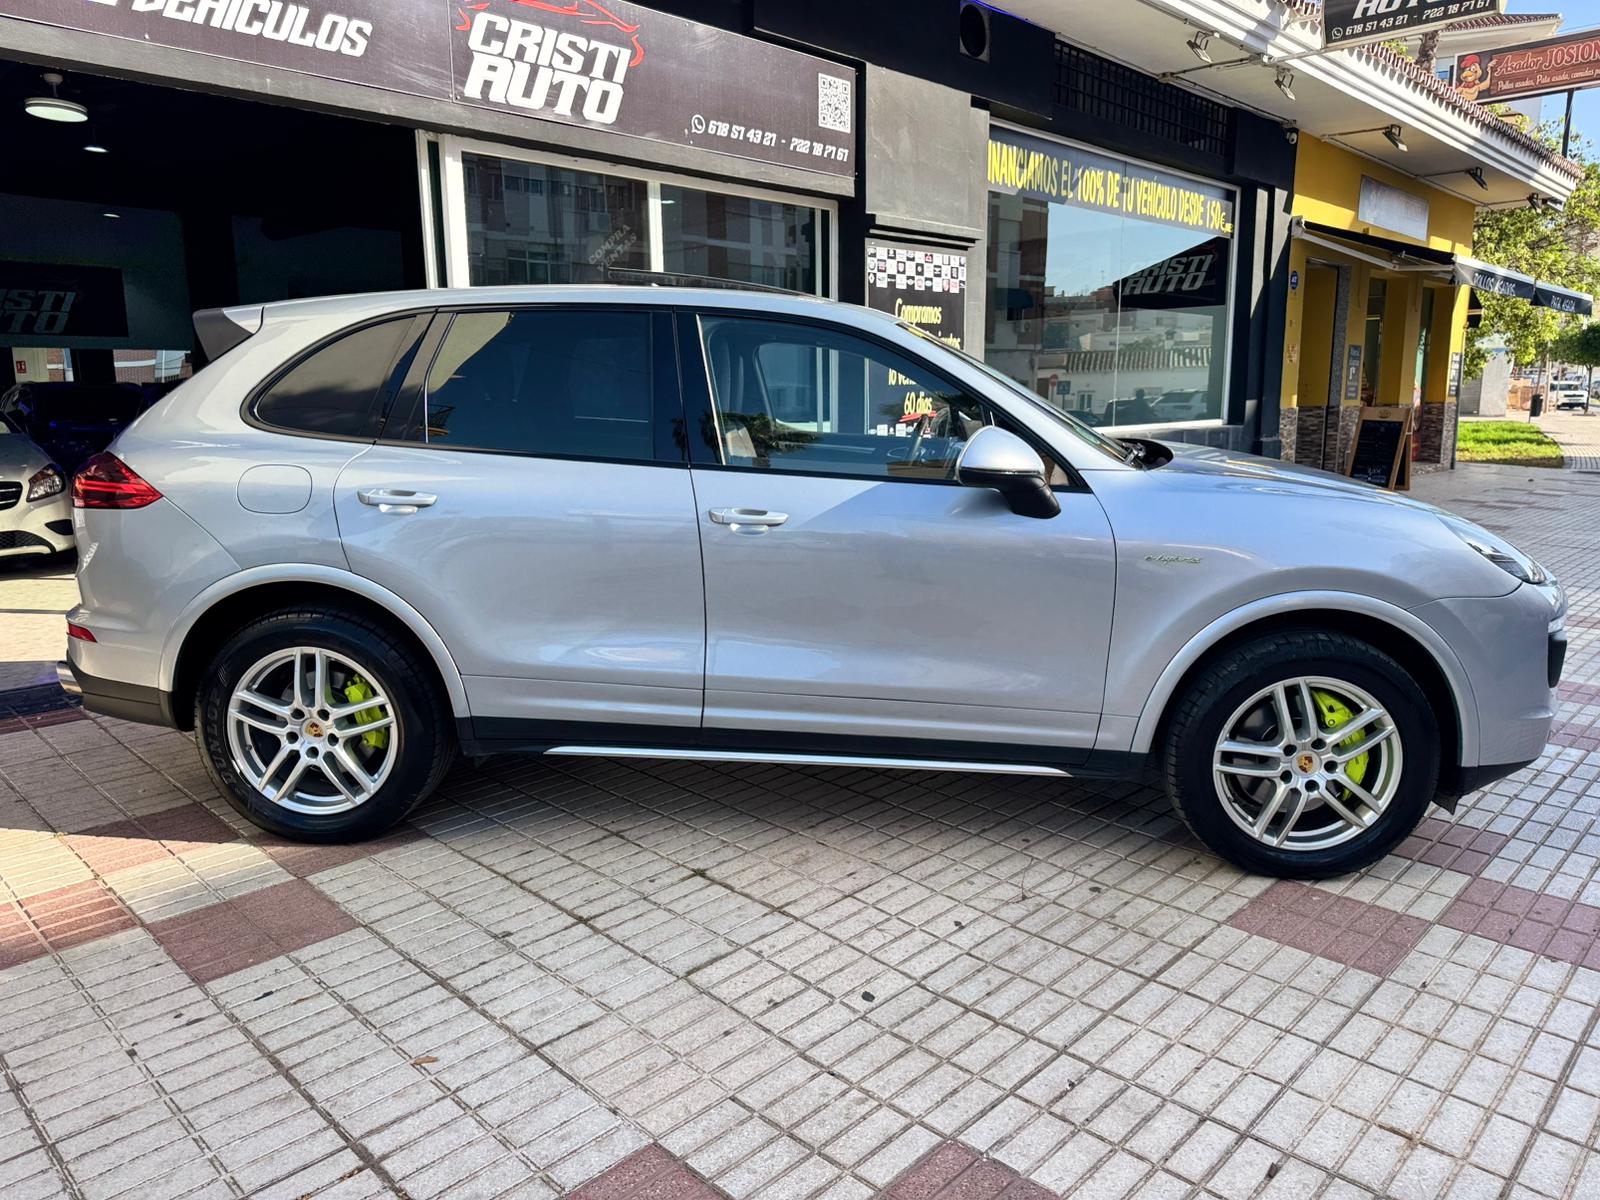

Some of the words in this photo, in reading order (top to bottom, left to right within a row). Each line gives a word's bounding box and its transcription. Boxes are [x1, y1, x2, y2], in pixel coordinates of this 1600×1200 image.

[1345, 24, 1363, 36] 618
[1380, 17, 1393, 28] 43
[1422, 6, 1445, 19] 722
[468, 12, 632, 84] CRISTI
[1495, 52, 1543, 76] Asador
[464, 51, 624, 124] AUTO
[707, 120, 730, 137] 618
[746, 128, 763, 144] 43
[789, 137, 811, 154] 722
[812, 141, 824, 156] 18
[987, 139, 1059, 197] INANCIAMOS
[1061, 160, 1074, 199] EL
[1077, 168, 1105, 206] 100%
[1106, 170, 1120, 208] DE
[1122, 176, 1135, 212] TU
[1178, 188, 1205, 226] DESDE
[588, 224, 631, 265] COMPRA
[1122, 271, 1206, 296] AUTO
[895, 298, 942, 326] Compramos
[904, 391, 916, 415] 60
